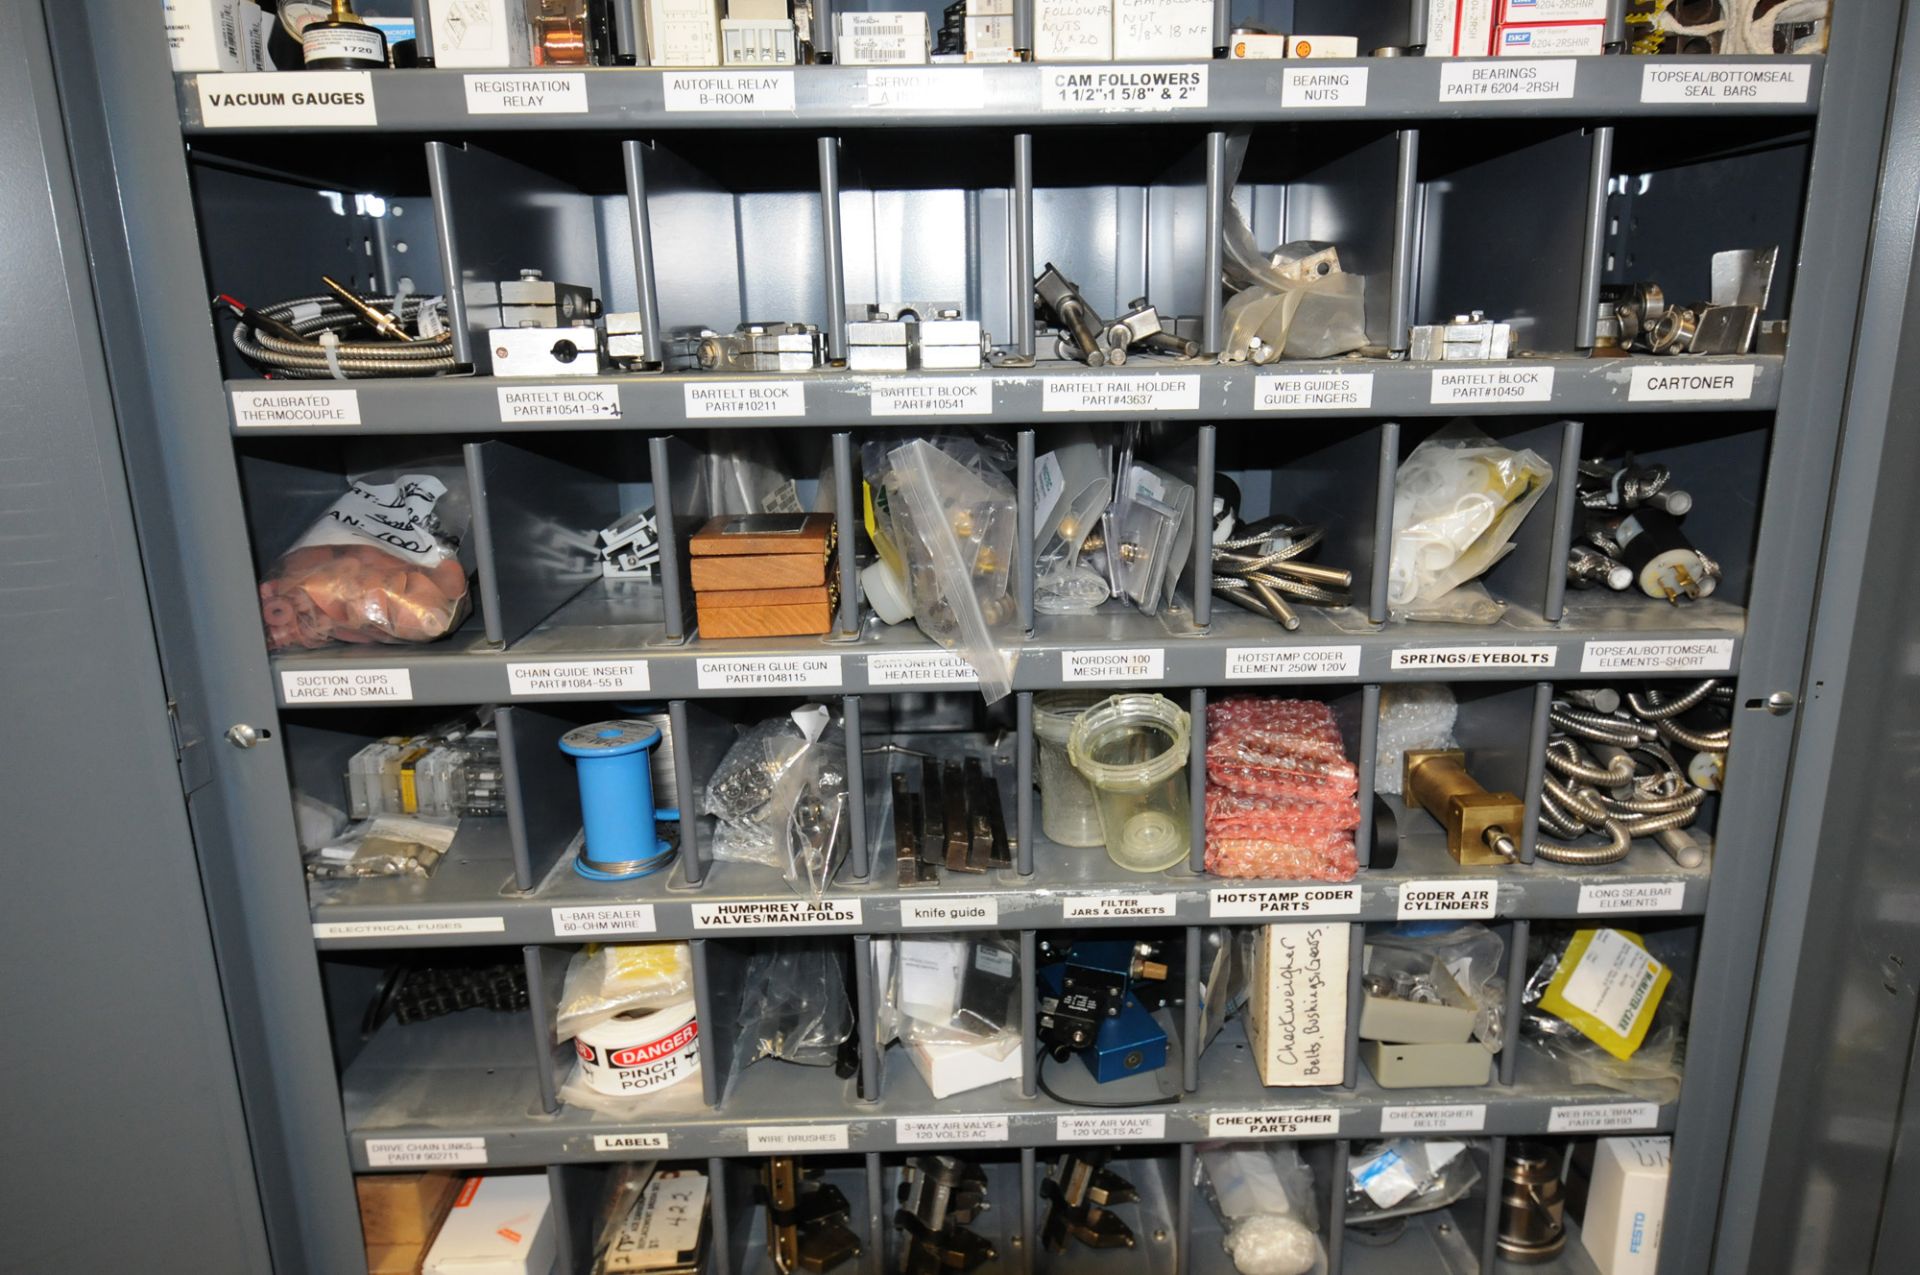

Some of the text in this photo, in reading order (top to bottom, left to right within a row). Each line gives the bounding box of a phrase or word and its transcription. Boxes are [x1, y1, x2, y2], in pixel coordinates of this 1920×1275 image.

[1123, 11, 1156, 24] NUT
[1042, 20, 1081, 32] NUTS
[343, 45, 373, 54] 1720
[1055, 72, 1201, 87] CAM FOLLOWERS
[1472, 67, 1537, 80] BEARINGS
[1650, 71, 1795, 83] TOPSEAL/BOTTOMSEAL
[673, 79, 779, 90] AUTOFILL RELAY
[1293, 74, 1350, 86] BEARING
[474, 80, 571, 93] REGISTRATION
[1447, 81, 1560, 95] PART# 6204-2RSH
[1684, 85, 1758, 97] SEAL BARS
[700, 93, 755, 105] B-ROOM
[1122, 86, 1155, 100] 5/8"
[1161, 88, 1172, 100] &
[1304, 89, 1339, 100] NUTS
[209, 92, 365, 107] VACUUM GAUGES
[503, 96, 544, 107] RELAY
[1441, 373, 1539, 385] BARTELT BLOCK
[1646, 376, 1735, 391] CARTONER
[880, 385, 978, 397] BARTELT BLOCK
[1050, 381, 1187, 394] BARTELT RAIL HOLDER
[1274, 380, 1350, 392] WEB GUIDES
[1452, 386, 1525, 398] PART#10450
[505, 391, 605, 404] BARTELT BLOCK
[691, 387, 789, 399] BARTELT BLOCK
[1264, 392, 1358, 404] GUIDE FINGERS
[253, 396, 330, 408] CALIBRATED
[893, 399, 964, 410] PART#10541
[1082, 394, 1153, 405] PART#43637
[705, 400, 777, 412] PART#10211
[243, 408, 345, 421] THERMOCOUPLE
[1588, 644, 1720, 657] TOPSEAL/BOTTOMSEAL
[1071, 654, 1151, 665] NORDSON 100
[1237, 651, 1344, 664] HOTSTAMP CODER
[1399, 653, 1550, 665] SPRINGS/EYEBOLTS
[1599, 656, 1706, 668] ELEMENTS-SHORT
[515, 666, 635, 679] CHAIN GUIDE INSERT
[703, 661, 828, 673] CARTONER GLUE GUN
[1073, 665, 1148, 676] MESH FILTER
[1232, 662, 1348, 674] ELEMENT 250W 120V
[726, 673, 807, 684] PART#1048115
[885, 668, 979, 680] HEATER ELEMEN
[296, 674, 388, 687] SUCTION CUPS
[530, 677, 623, 689] PART#1084-55 B
[290, 686, 398, 698] LARGE AND SMALL
[1217, 890, 1354, 904] HOTSTAMP CODER
[1406, 890, 1489, 901] CODER AIR
[1588, 887, 1672, 899] LONG SEALBAR
[718, 902, 834, 914] HUMPHREY AIR
[1101, 899, 1138, 908] FILTER
[1260, 901, 1310, 912] PARTS
[1403, 901, 1489, 911] CYLINDERS
[1599, 898, 1658, 908] ELEMENTS
[560, 910, 641, 921] L-BAR SEALER
[915, 906, 986, 920] knife guide
[1071, 908, 1099, 916] JARS
[1114, 906, 1165, 916] GASKETS
[700, 911, 854, 925] VALVES/MANIFOLDS
[329, 921, 463, 934] ELECTRICAL FUSES
[563, 920, 640, 932] 60-OHM WIRE
[622, 1026, 693, 1064] DANGER
[619, 1057, 677, 1079] PINCH
[621, 1067, 679, 1090] POINT
[1216, 1114, 1332, 1125] CHECKWEIGHER
[1389, 1109, 1474, 1119] CHECKWEIGHER
[904, 1122, 940, 1131] 3-WAY
[942, 1122, 961, 1130] AIR
[1062, 1118, 1151, 1129] 5-WAY AIR VALVE
[1250, 1124, 1297, 1133] PARTS
[1413, 1119, 1447, 1128] BELTS
[916, 1130, 987, 1139] 120 VOLTS AC
[1073, 1127, 1143, 1136] 120 VOLTS AC
[604, 1137, 661, 1147] LABELS
[758, 1134, 837, 1144] WIRE BRUSHES
[371, 1142, 473, 1153] DRIVE CHAIN LINKS
[387, 1153, 421, 1161] PART#
[1630, 1212, 1646, 1254] FESTO
